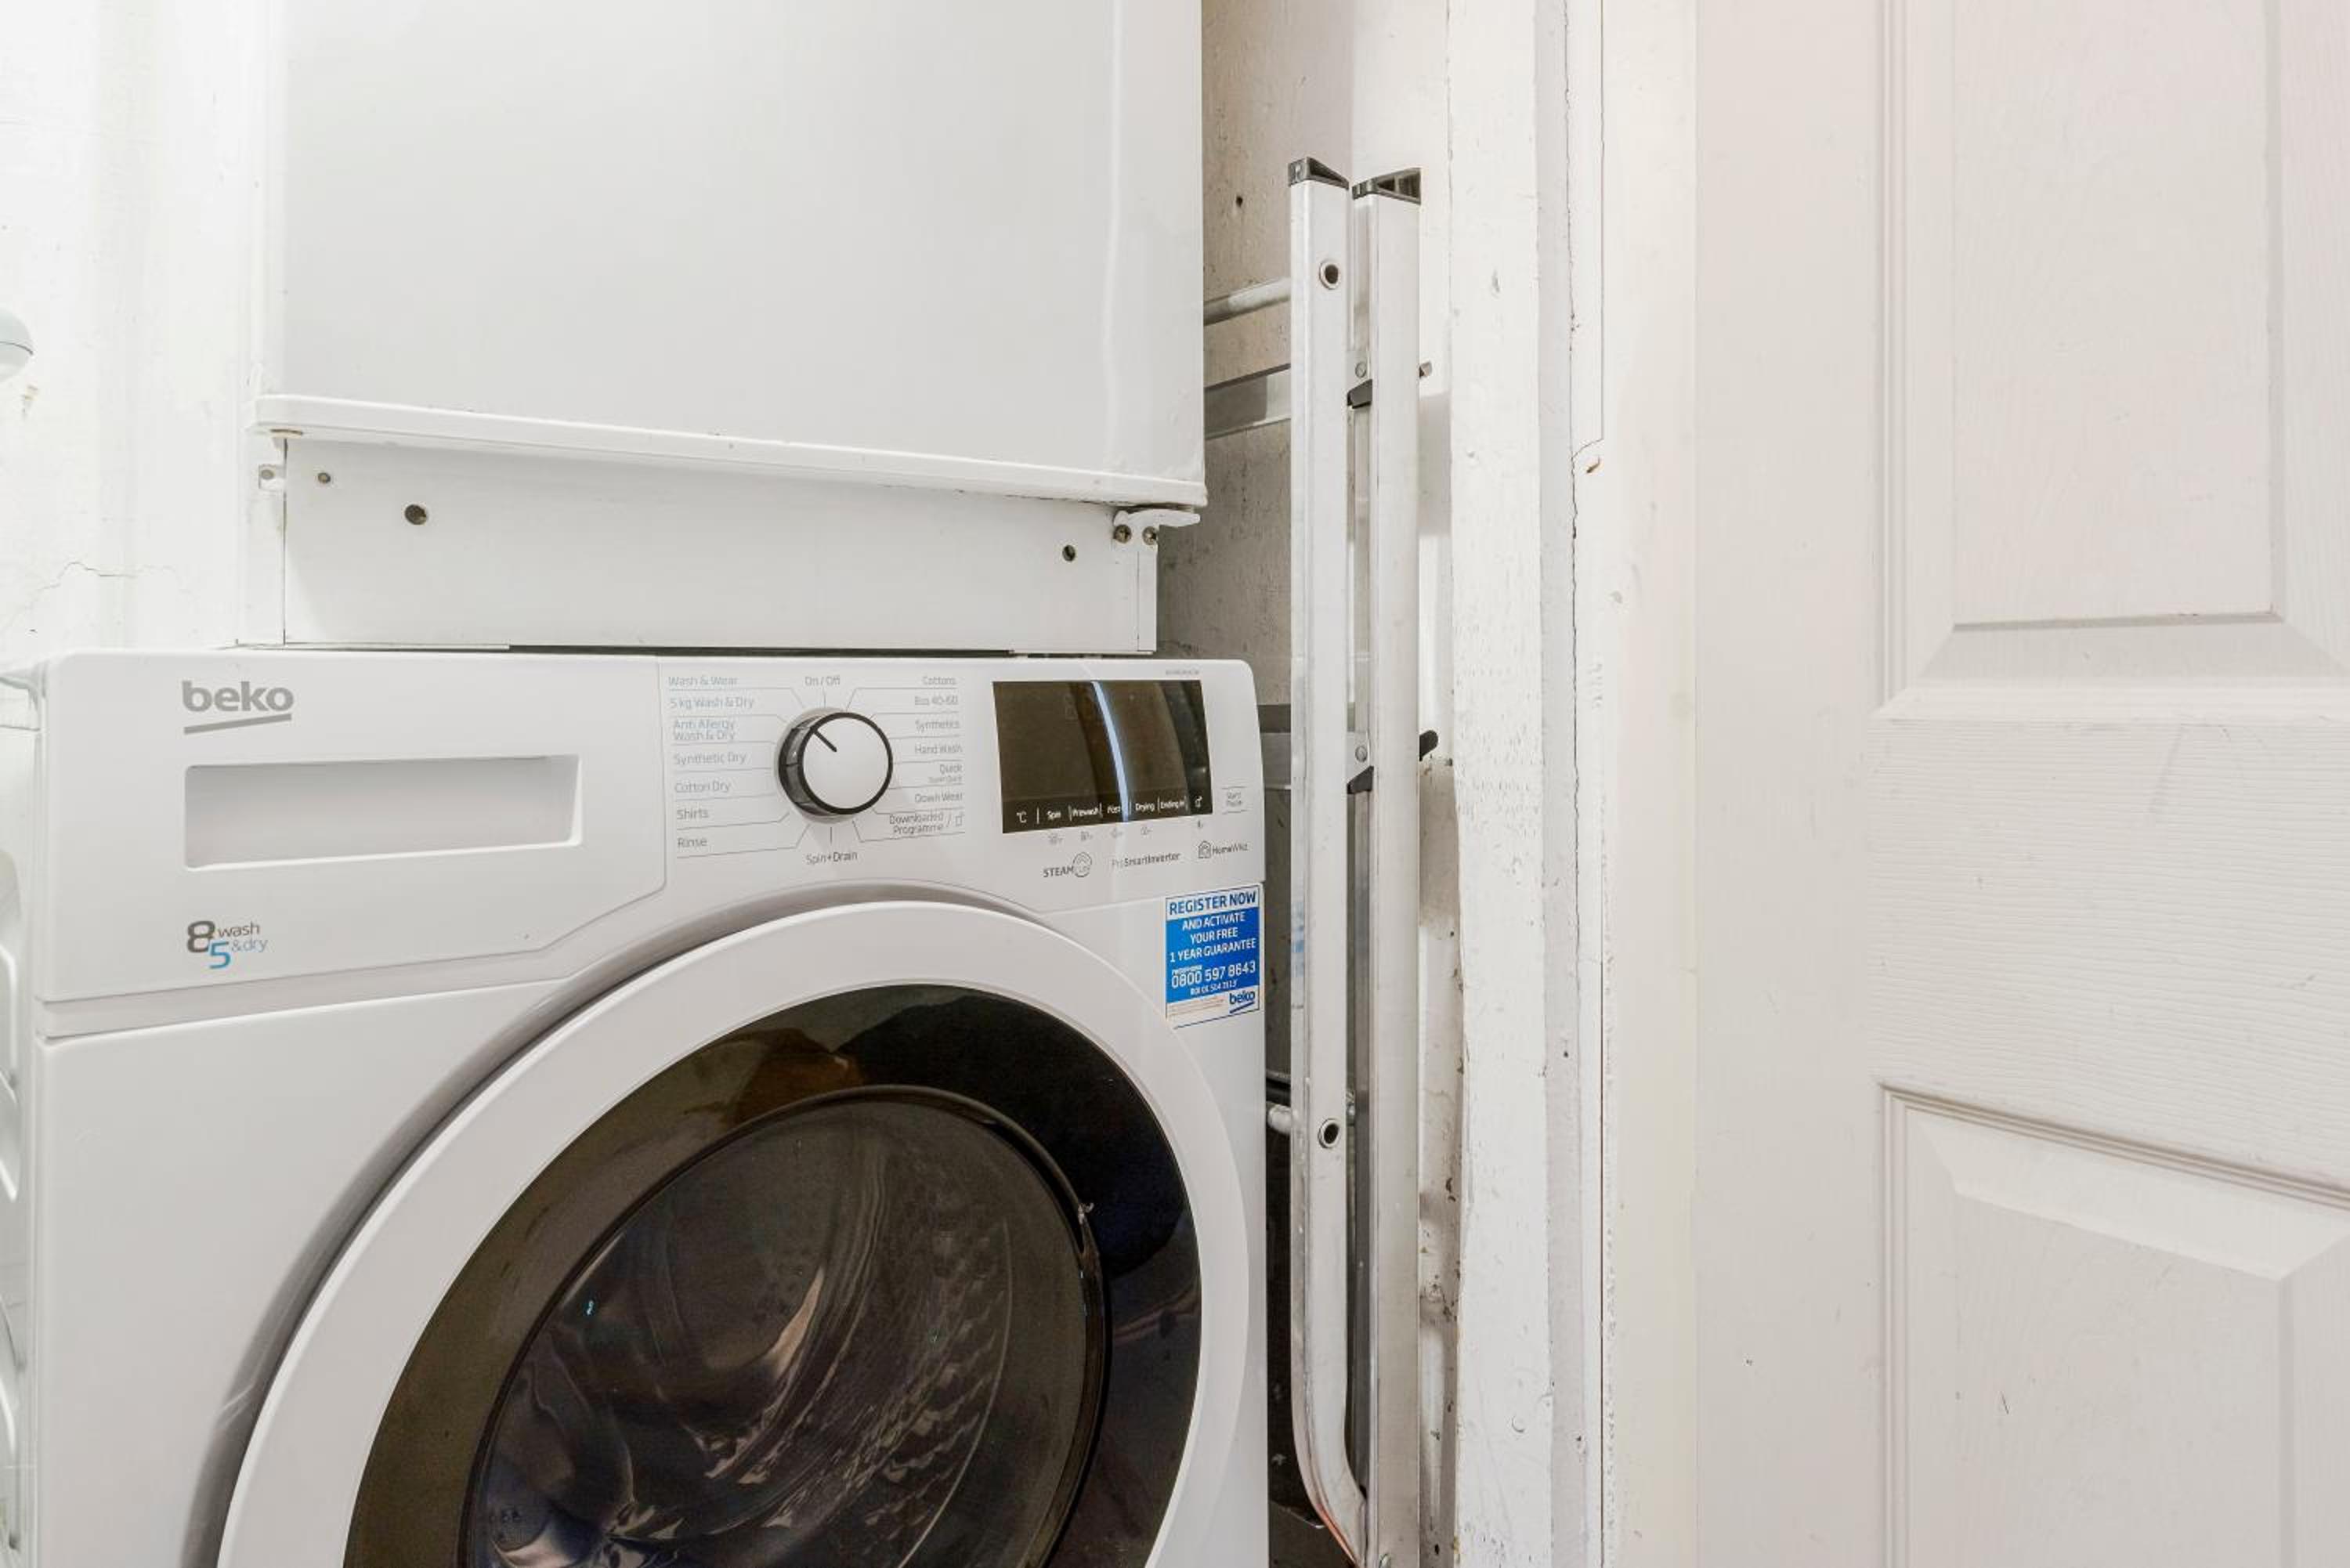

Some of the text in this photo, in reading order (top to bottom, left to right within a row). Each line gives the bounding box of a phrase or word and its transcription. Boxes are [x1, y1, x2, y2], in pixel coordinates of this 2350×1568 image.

[668, 676, 738, 686] Wash & Wear
[805, 676, 819, 686] On
[826, 676, 841, 686] Off
[182, 680, 294, 712] beko
[736, 696, 754, 709] Dry
[915, 743, 938, 755] Hand
[674, 751, 747, 766] Synthetic Dry
[674, 780, 732, 793] Cotton Dry
[676, 808, 709, 820] Shirts
[1135, 803, 1155, 813] Drying
[890, 811, 944, 826] Downloaded
[678, 837, 707, 848] Rinse
[1043, 865, 1074, 878] STEAM
[1170, 891, 1256, 916] REGISTER NOW
[1182, 911, 1246, 931] AND ACTIVATE
[187, 920, 260, 953] 8 wash
[1190, 927, 1238, 945] YOUR FREE
[209, 941, 231, 970] 5
[1170, 938, 1256, 963] 1 YEAR GUARANTEE
[1171, 971, 1202, 988] 0800
[1205, 966, 1226, 981] 597
[1227, 960, 1256, 977] 8643
[1229, 990, 1256, 1005] beko
